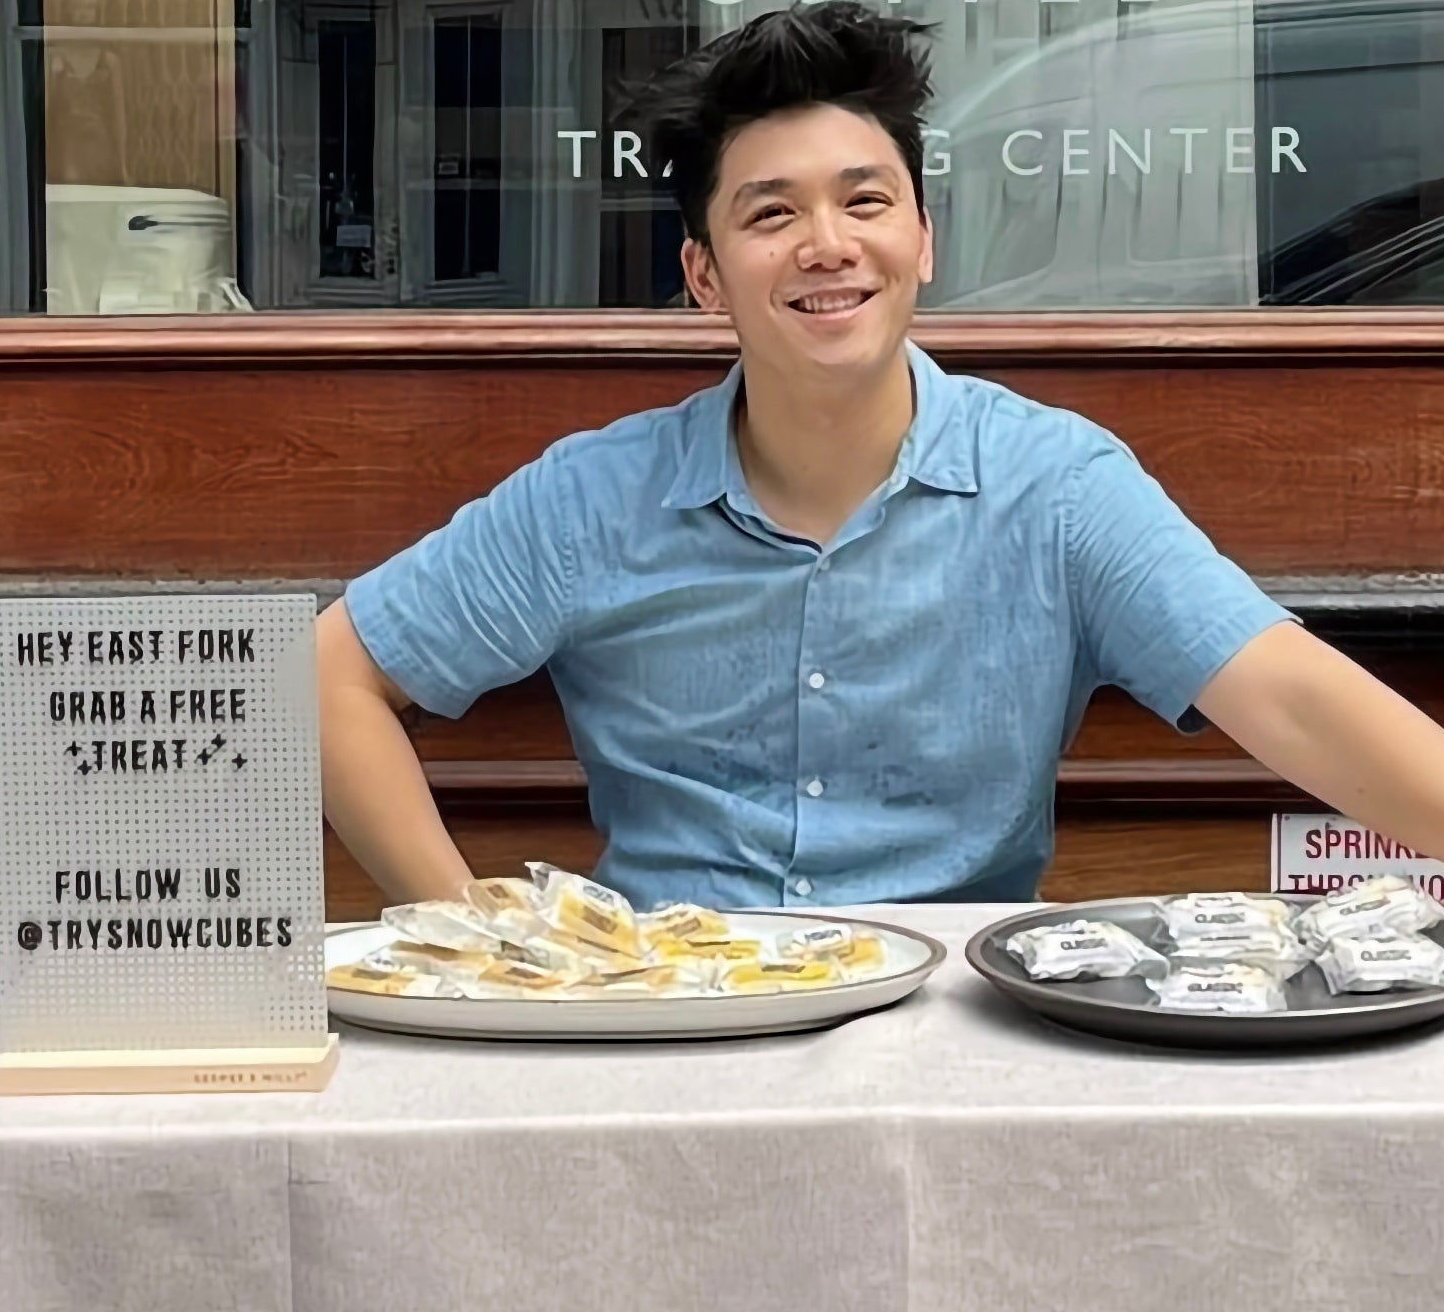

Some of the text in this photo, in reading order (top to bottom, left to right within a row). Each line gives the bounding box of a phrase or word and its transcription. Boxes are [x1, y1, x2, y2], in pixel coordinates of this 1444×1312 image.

[1002, 127, 1308, 176] CENTER
[18, 629, 255, 666] HEY EAST FORK
[50, 689, 247, 723] GRAB A FREE
[92, 740, 186, 772] TREAT
[55, 868, 241, 903] FOLLOW US
[17, 918, 293, 952] @TRYSNOWCUBES
